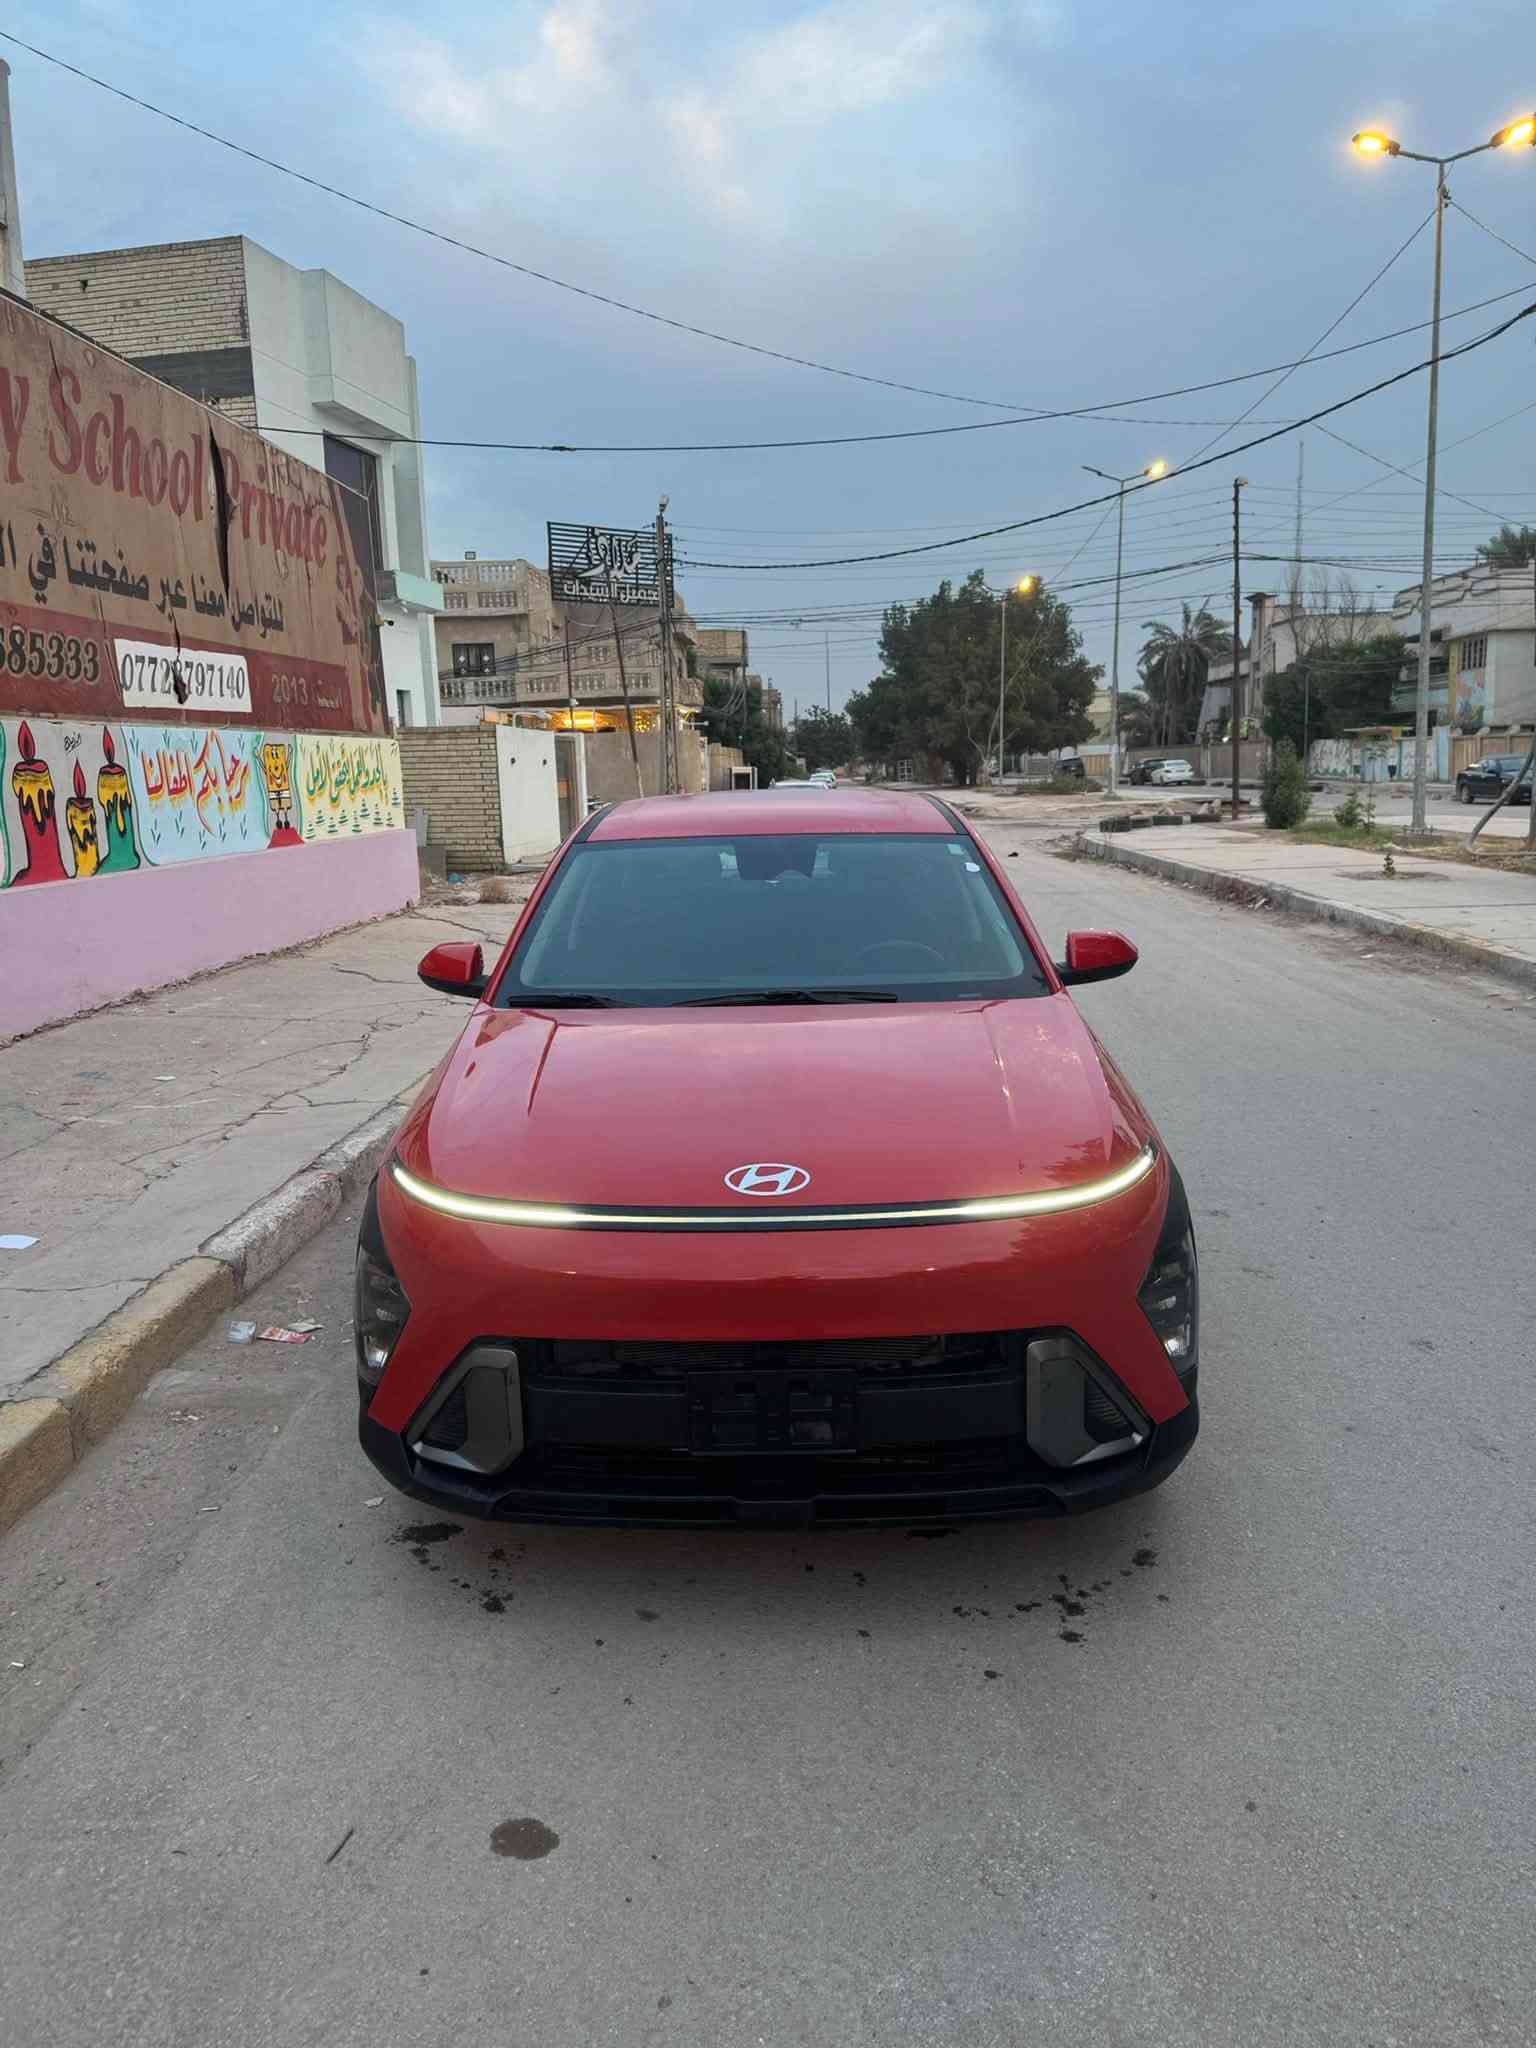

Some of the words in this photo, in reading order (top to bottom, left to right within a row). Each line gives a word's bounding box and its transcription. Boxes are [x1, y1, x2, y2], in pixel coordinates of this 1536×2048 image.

[50, 366, 205, 523] School
[28, 522, 57, 605] في
[62, 535, 149, 601] صفحتنا
[155, 576, 187, 624] عبر
[191, 573, 225, 617] معنا
[231, 587, 284, 639] للتواصل
[271, 672, 309, 705] 2013
